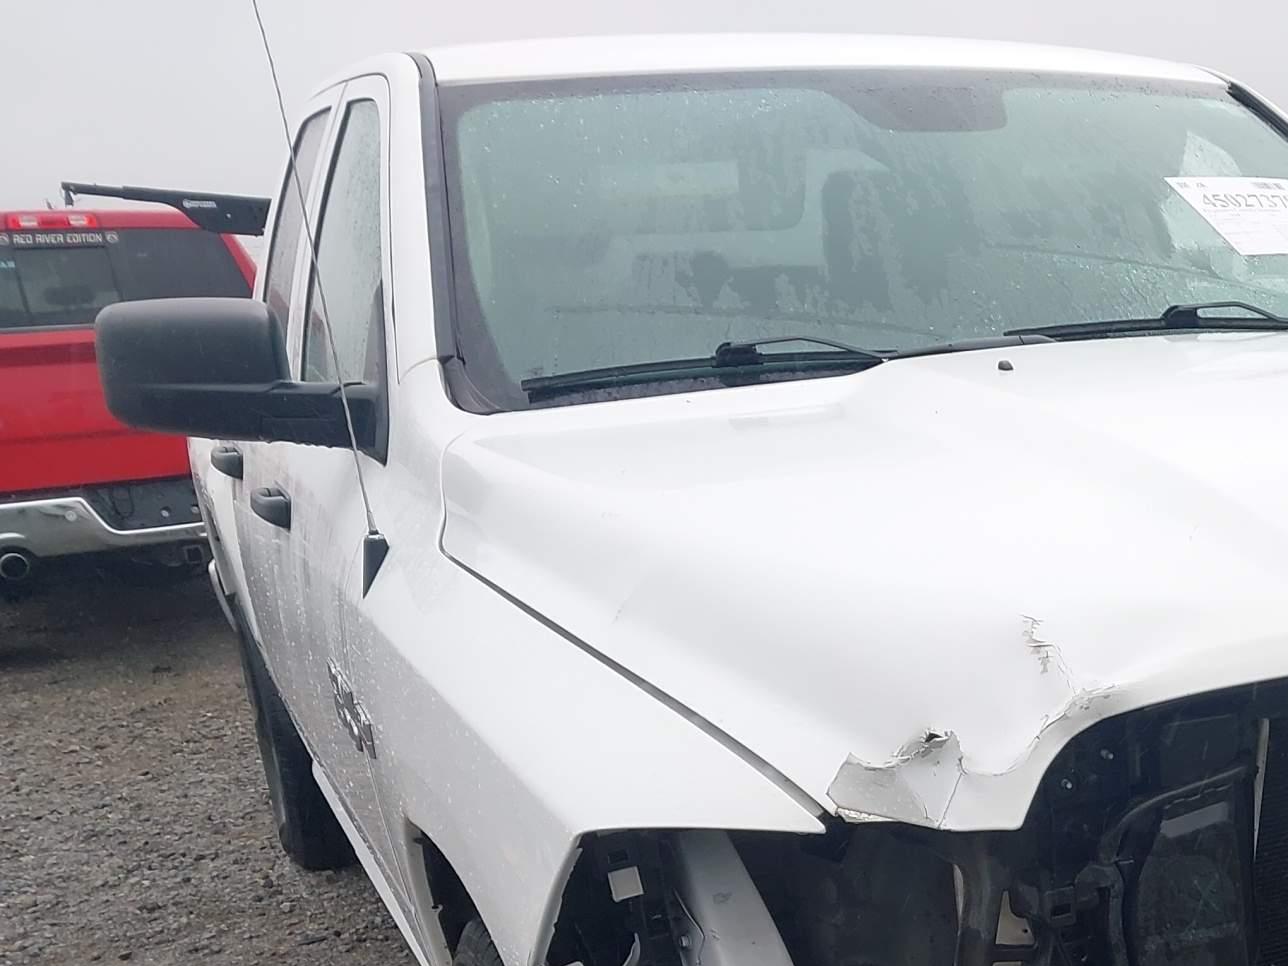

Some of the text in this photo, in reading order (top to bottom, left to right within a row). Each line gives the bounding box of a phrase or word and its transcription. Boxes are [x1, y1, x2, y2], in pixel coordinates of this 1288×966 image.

[12, 232, 103, 244] RED RIVER EDITION
